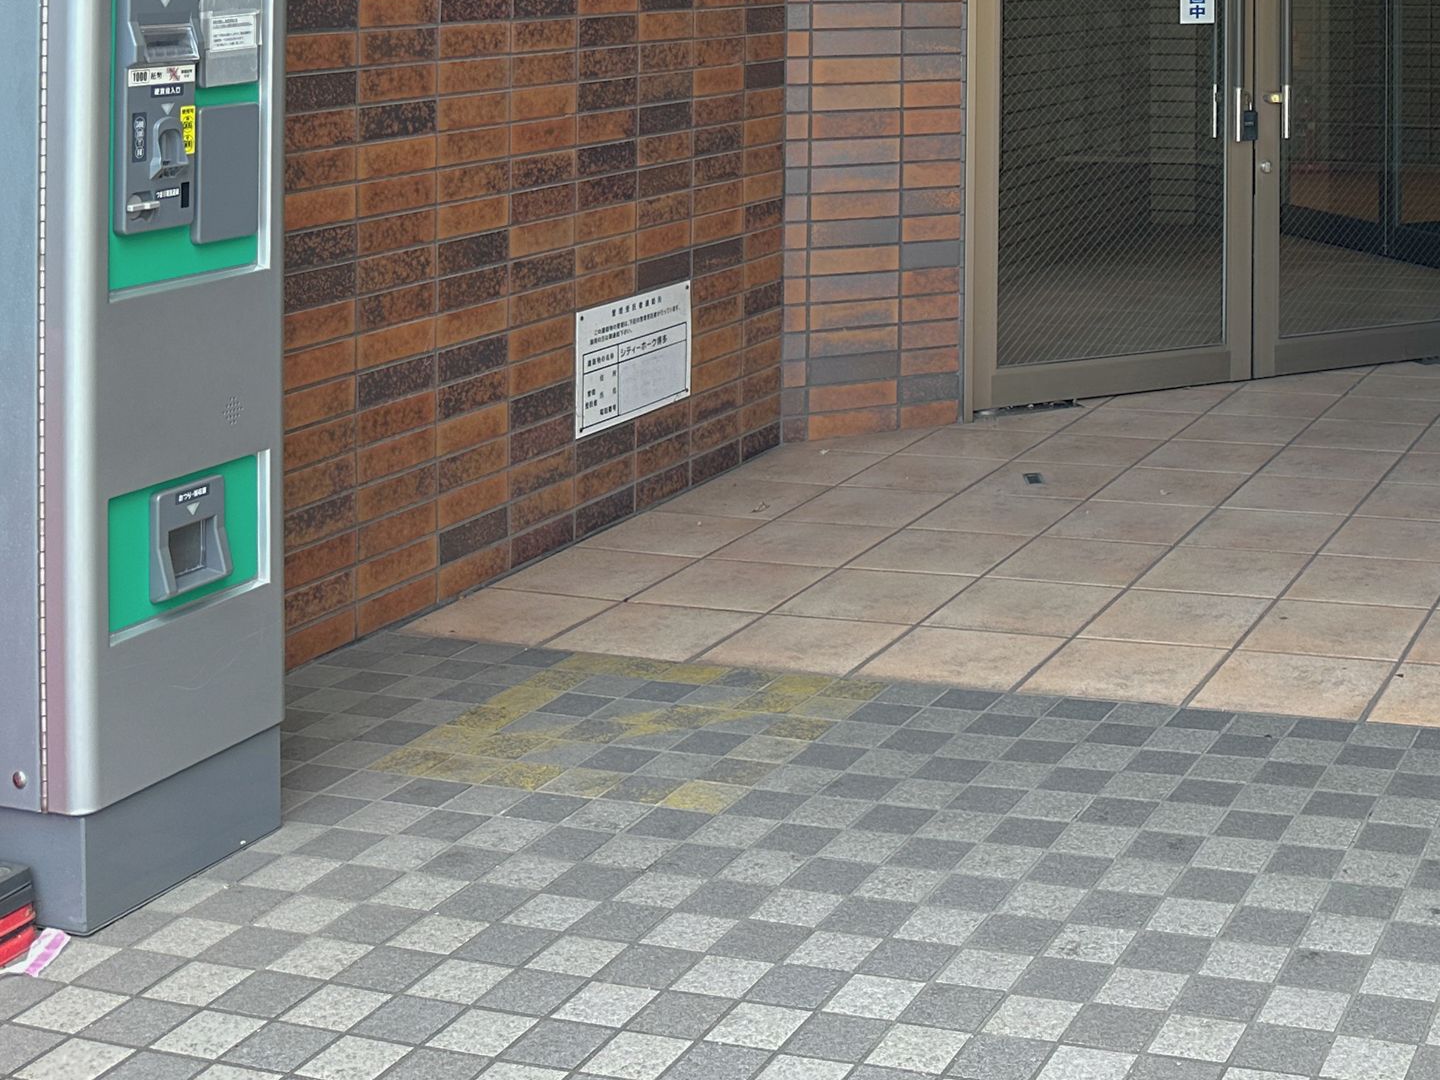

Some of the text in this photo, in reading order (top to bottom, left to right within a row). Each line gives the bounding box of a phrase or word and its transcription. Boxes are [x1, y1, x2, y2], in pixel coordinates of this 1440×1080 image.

[132, 71, 148, 82] 1000
[620, 334, 668, 358] シティーホーク博多
